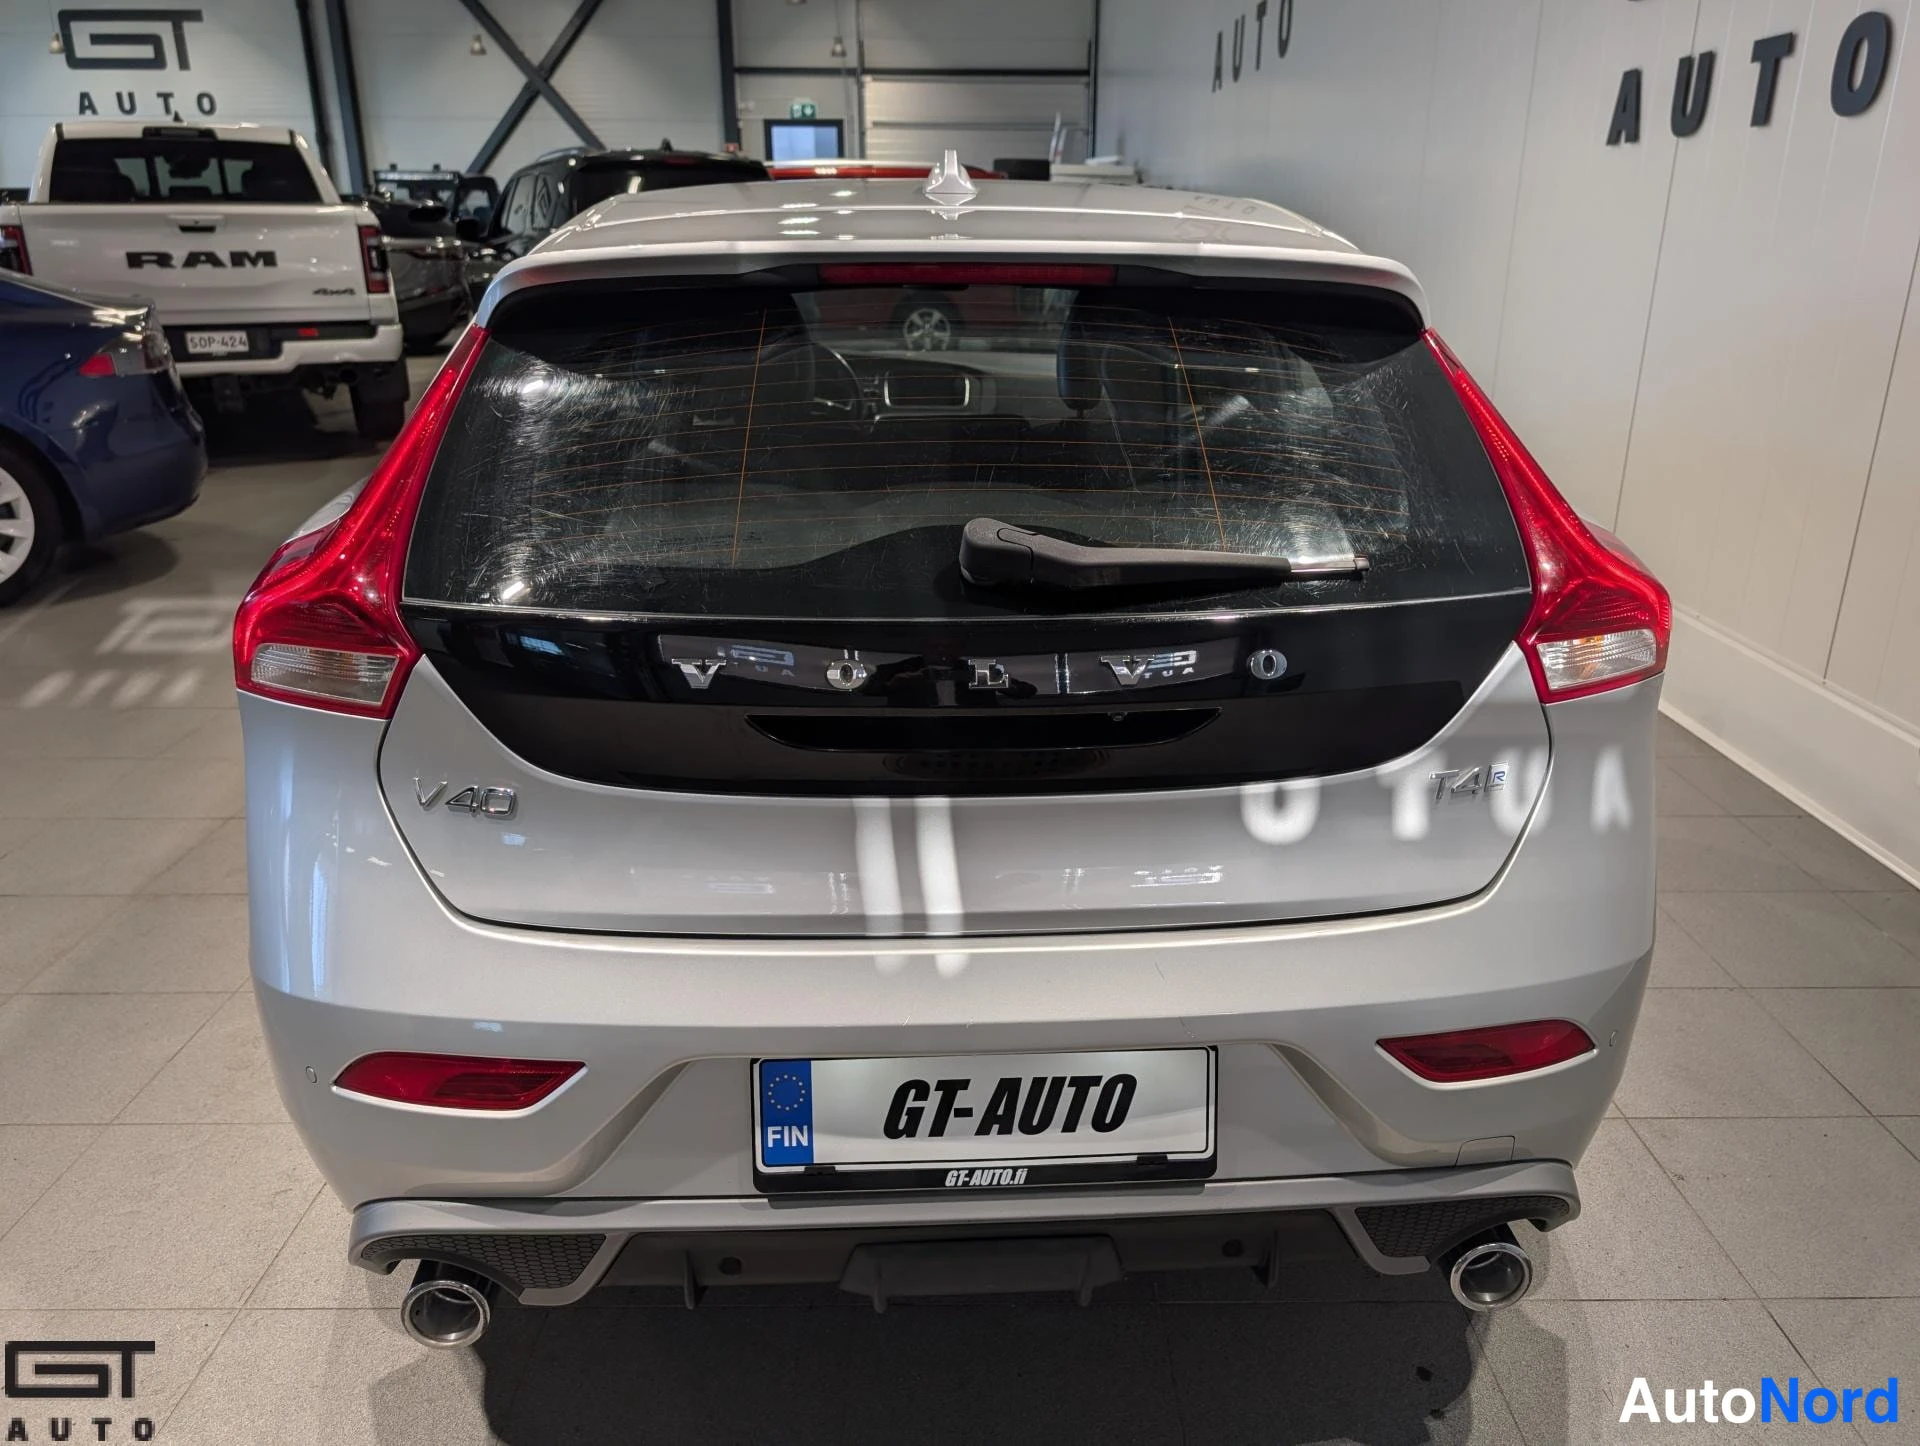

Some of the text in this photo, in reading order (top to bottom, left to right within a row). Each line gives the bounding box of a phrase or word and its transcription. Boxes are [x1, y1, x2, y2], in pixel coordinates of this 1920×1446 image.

[58, 9, 203, 70] GT
[1212, 0, 1292, 92] AUTO
[1606, 11, 1891, 145] AUTO
[79, 92, 216, 115] AUTO
[126, 251, 277, 269] RAM
[671, 649, 1288, 689] VOLVO
[413, 777, 517, 815] V40
[883, 1074, 1138, 1140] GT-AUTO
[767, 1125, 808, 1148] FIN
[945, 1168, 1028, 1187] GT-AUTO.fi
